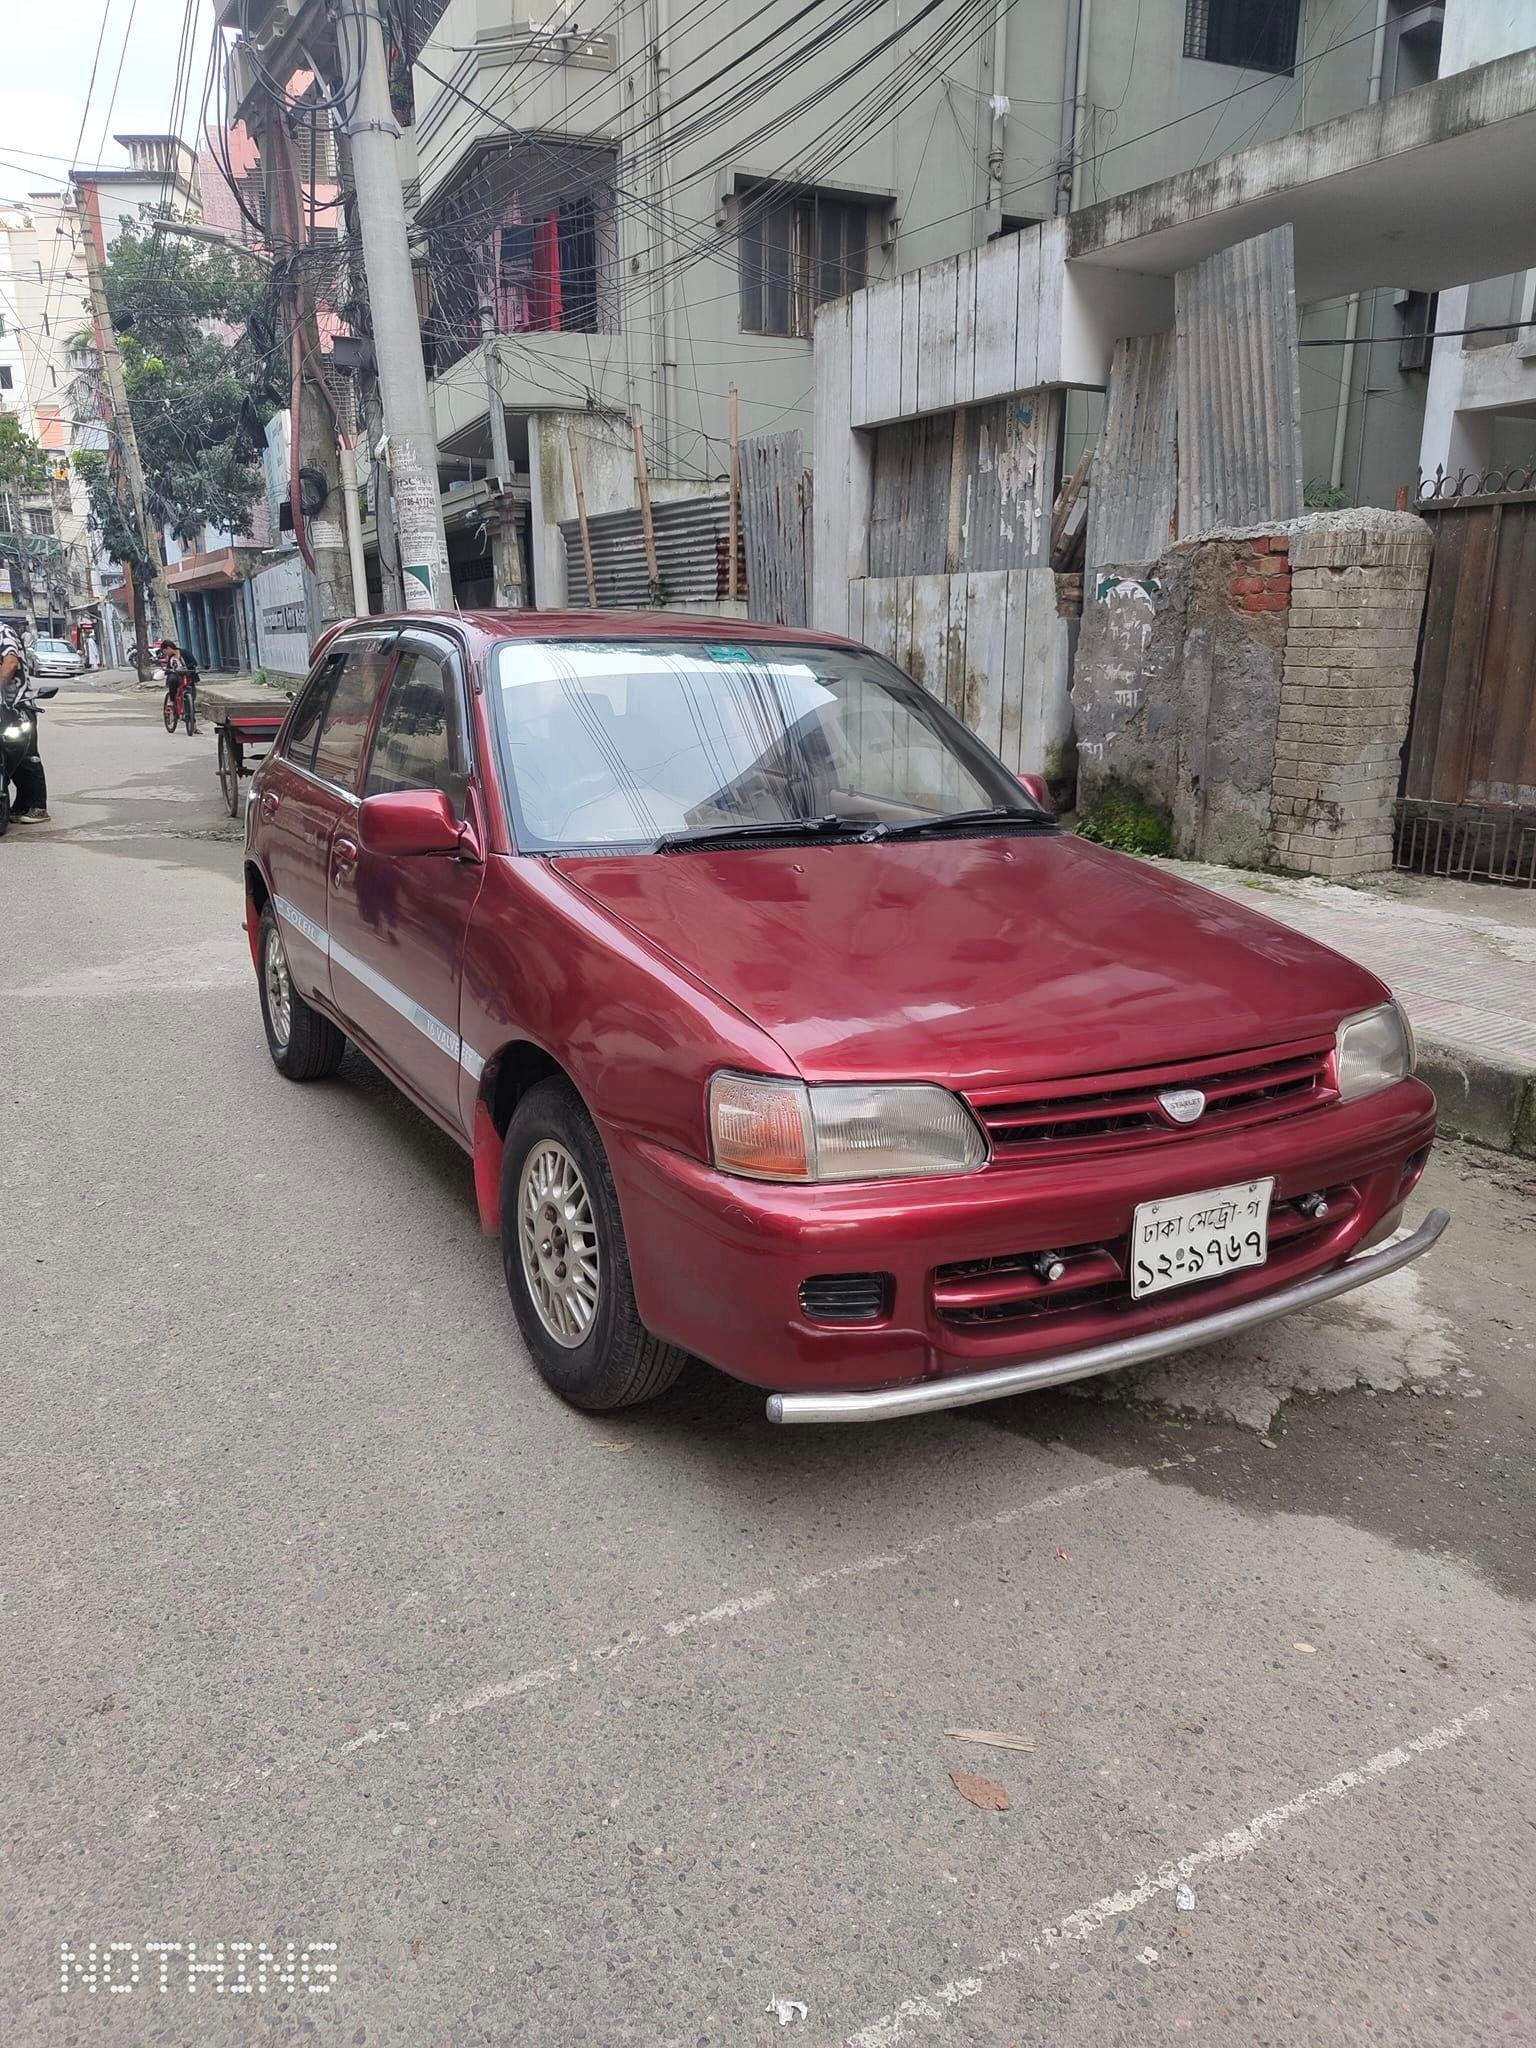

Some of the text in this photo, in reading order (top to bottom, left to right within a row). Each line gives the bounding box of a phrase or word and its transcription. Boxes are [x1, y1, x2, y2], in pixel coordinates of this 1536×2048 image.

[285, 907, 316, 940] SOLEIL
[427, 1019, 435, 1036] 16
[1169, 1098, 1201, 1110] STARLET
[1144, 1215, 1183, 1243] ঢাকা
[1137, 1231, 1262, 1288] ১২-৯৭৬৭
